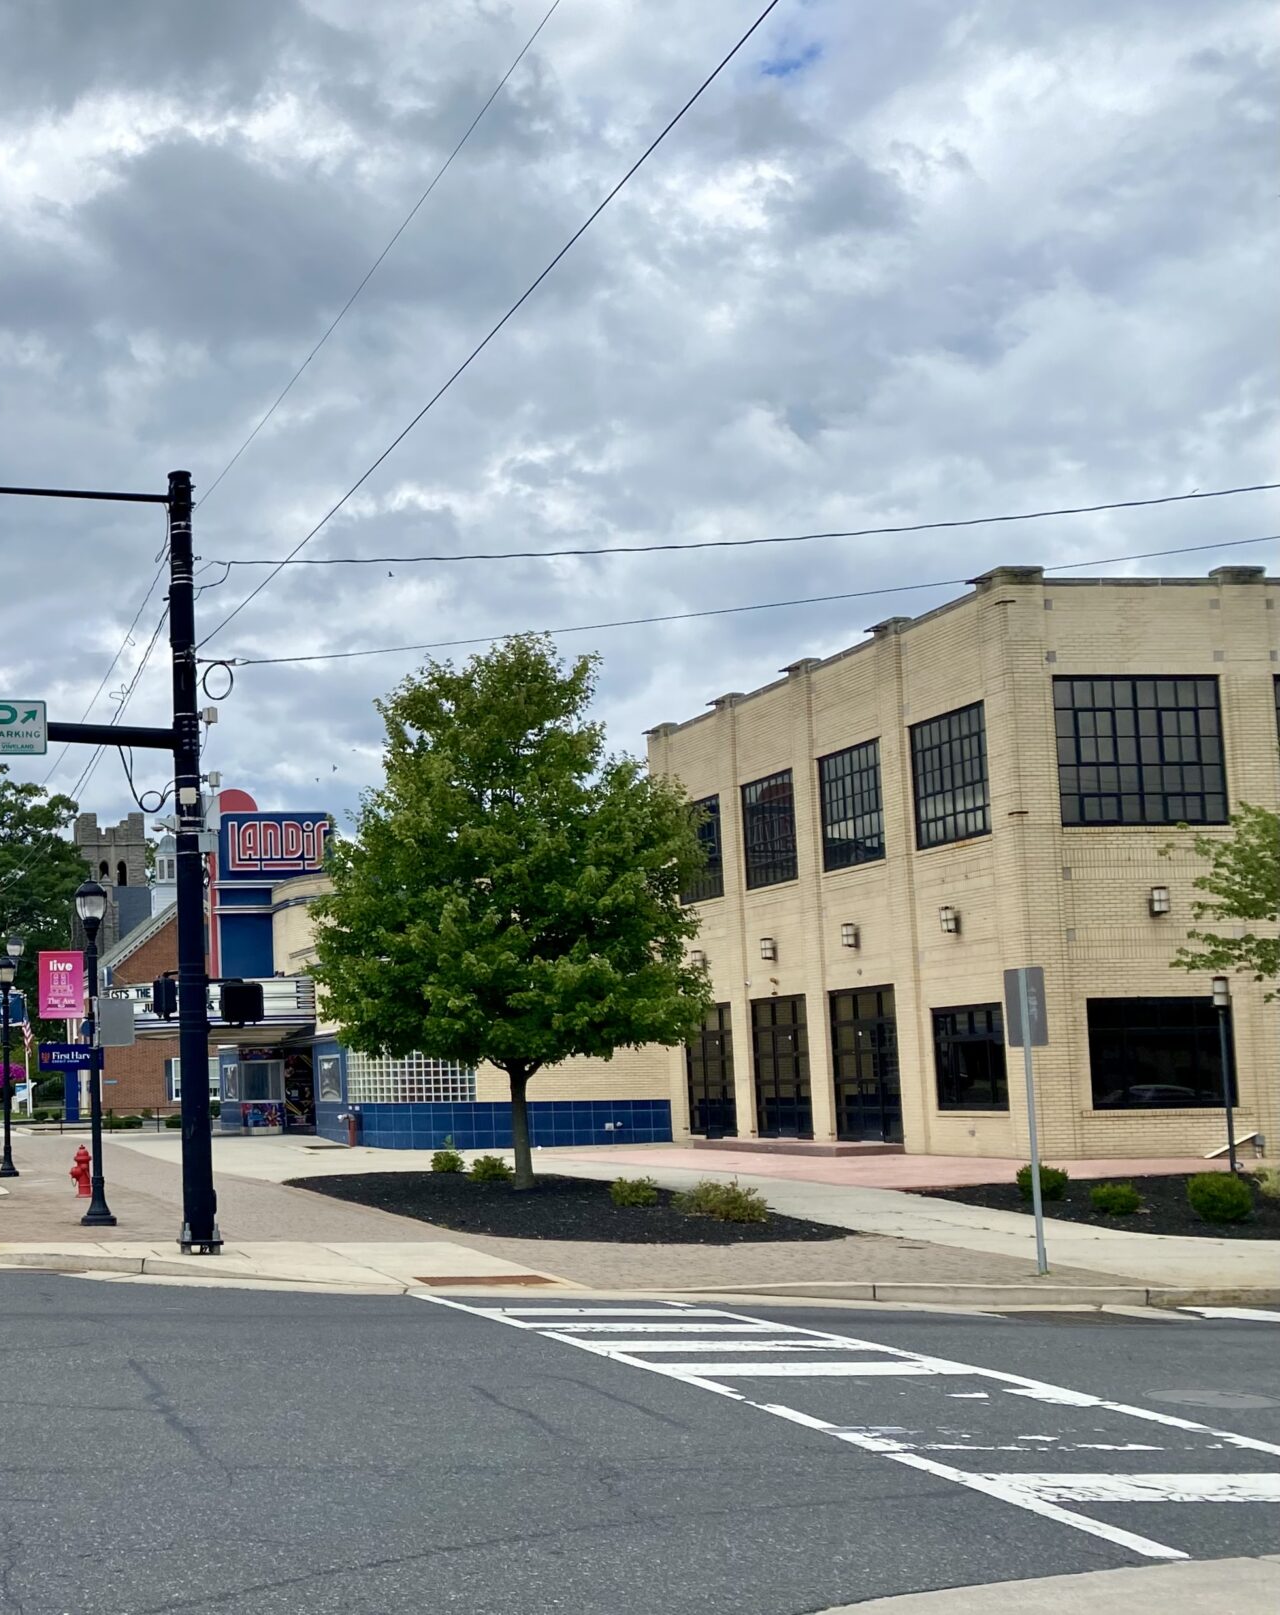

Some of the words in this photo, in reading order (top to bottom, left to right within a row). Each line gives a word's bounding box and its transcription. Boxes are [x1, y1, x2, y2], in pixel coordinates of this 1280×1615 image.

[49, 960, 73, 971] live
[135, 988, 152, 998] THE
[142, 1003, 153, 1013] JU
[52, 1051, 70, 1060] First
[71, 1051, 91, 1060] Harv
